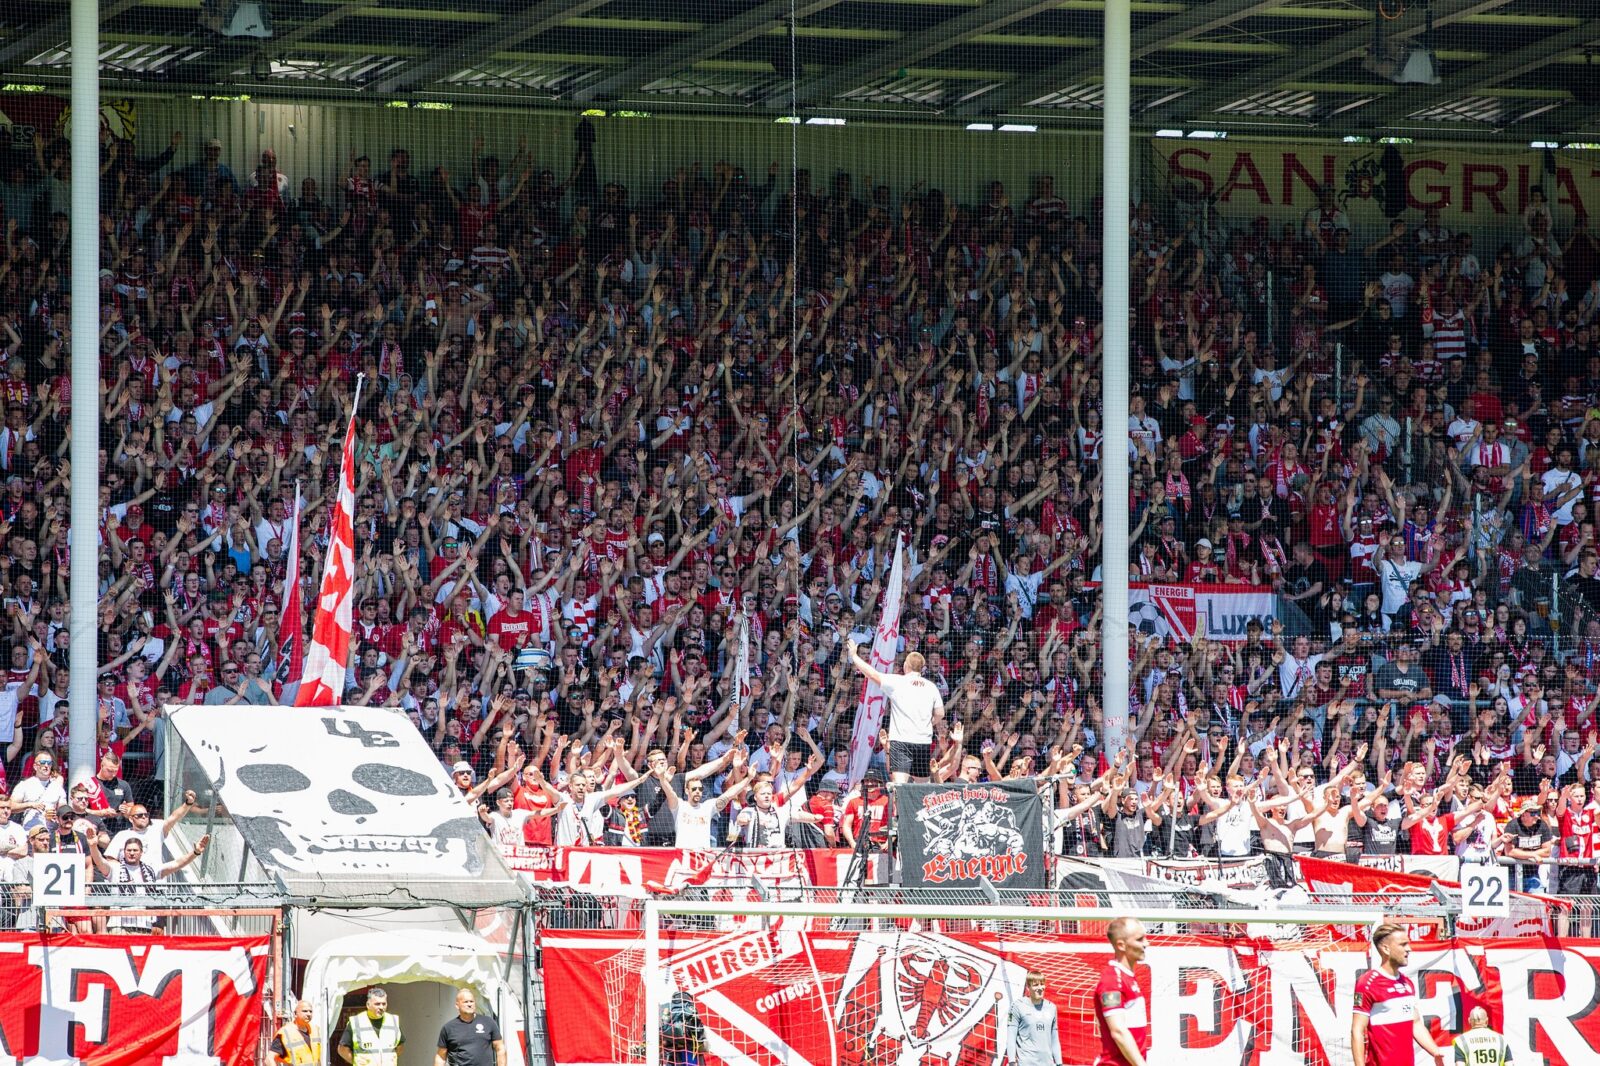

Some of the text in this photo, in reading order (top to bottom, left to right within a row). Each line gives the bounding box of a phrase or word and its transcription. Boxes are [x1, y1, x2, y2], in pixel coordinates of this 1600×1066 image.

[1167, 147, 1336, 206] SAN
[1154, 587, 1188, 598] ENERGIE
[1393, 678, 1417, 687] ORLANDO
[43, 863, 76, 896] 21
[922, 848, 1028, 884] Energie
[1467, 876, 1504, 907] 22
[671, 930, 783, 992] ENERGIE
[756, 980, 812, 1013] COTTBUS
[1473, 1048, 1497, 1064] 159
